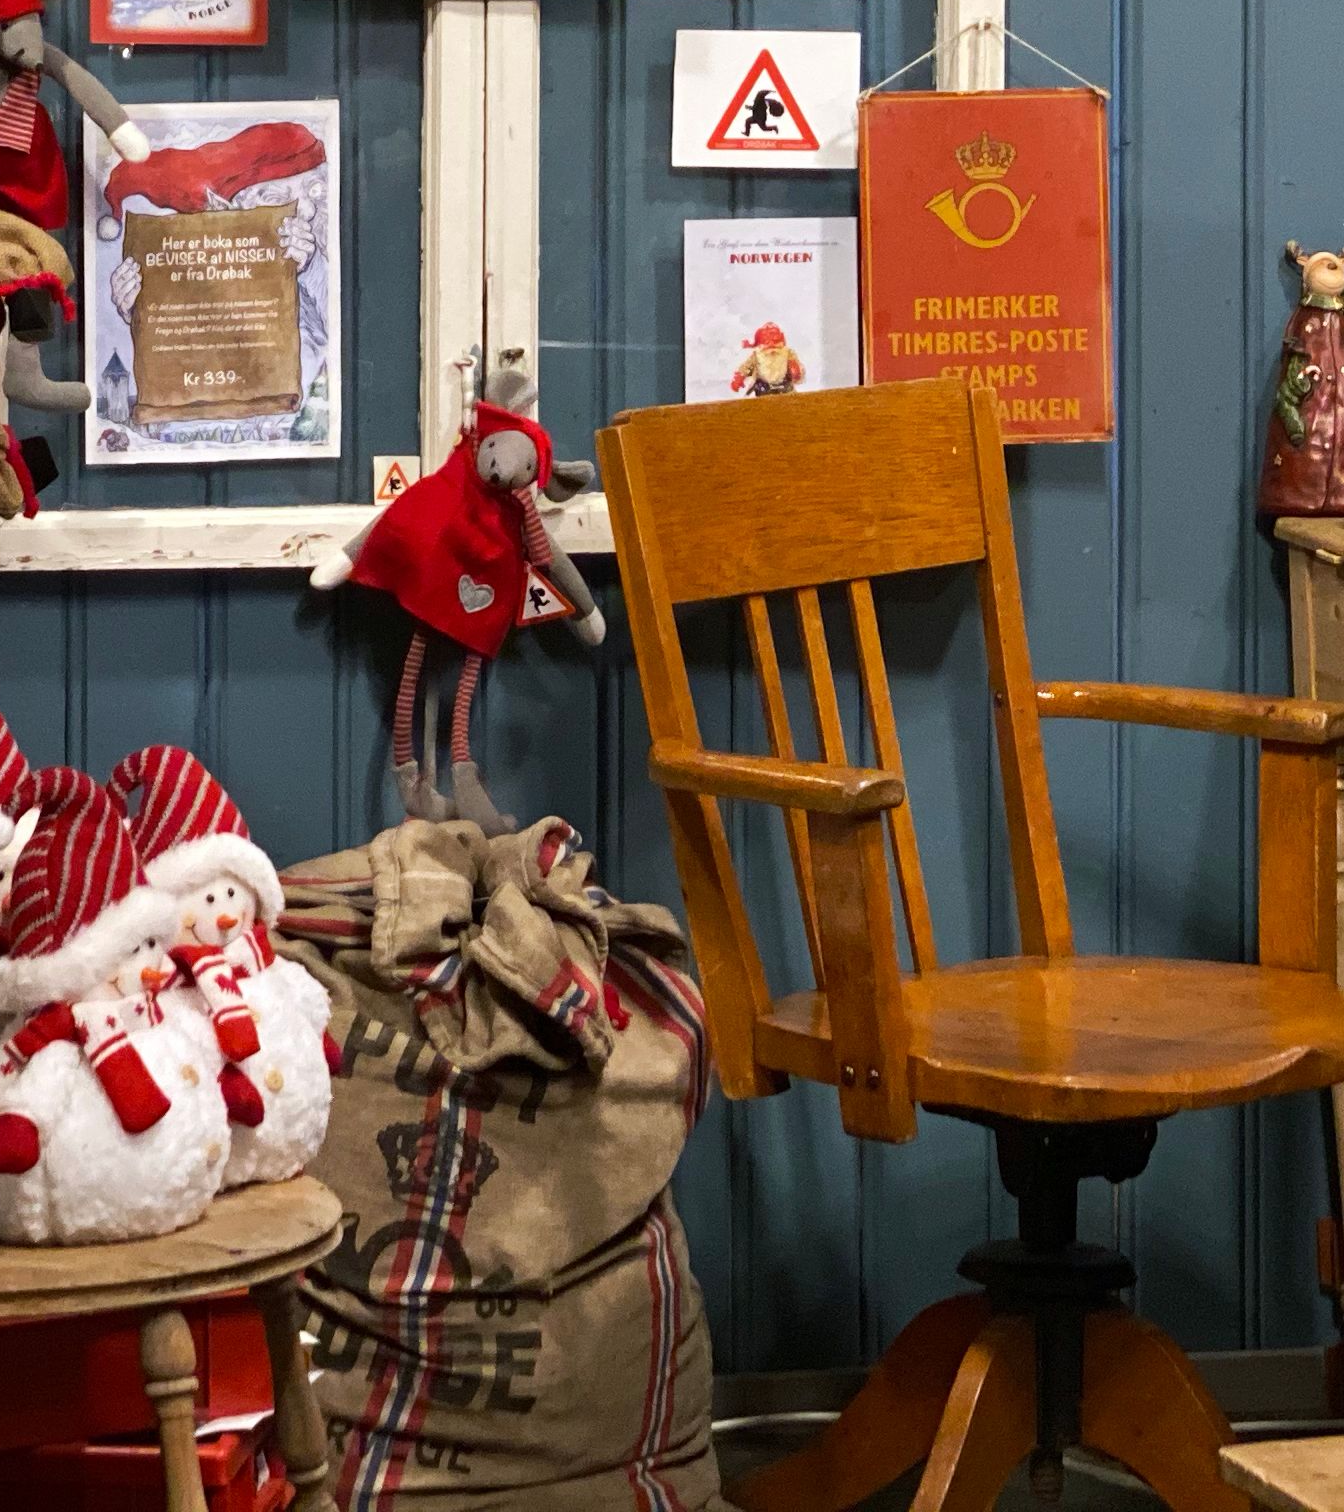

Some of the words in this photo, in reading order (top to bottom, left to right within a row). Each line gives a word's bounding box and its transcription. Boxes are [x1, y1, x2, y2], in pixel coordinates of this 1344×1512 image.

[162, 236, 185, 251] Her
[188, 239, 201, 249] er
[203, 234, 232, 249] boka
[235, 236, 260, 248] som
[145, 251, 207, 267] BEVISER
[210, 253, 223, 264] at
[225, 248, 276, 263] NISSEN
[729, 252, 814, 264] NORWEGEN
[170, 271, 182, 281] er
[186, 268, 205, 281] fra
[206, 265, 253, 281] Drøbak
[913, 294, 1060, 321] FRIMERKER
[887, 328, 1089, 356] TIMBRES-POSTE
[184, 372, 200, 386] Kr
